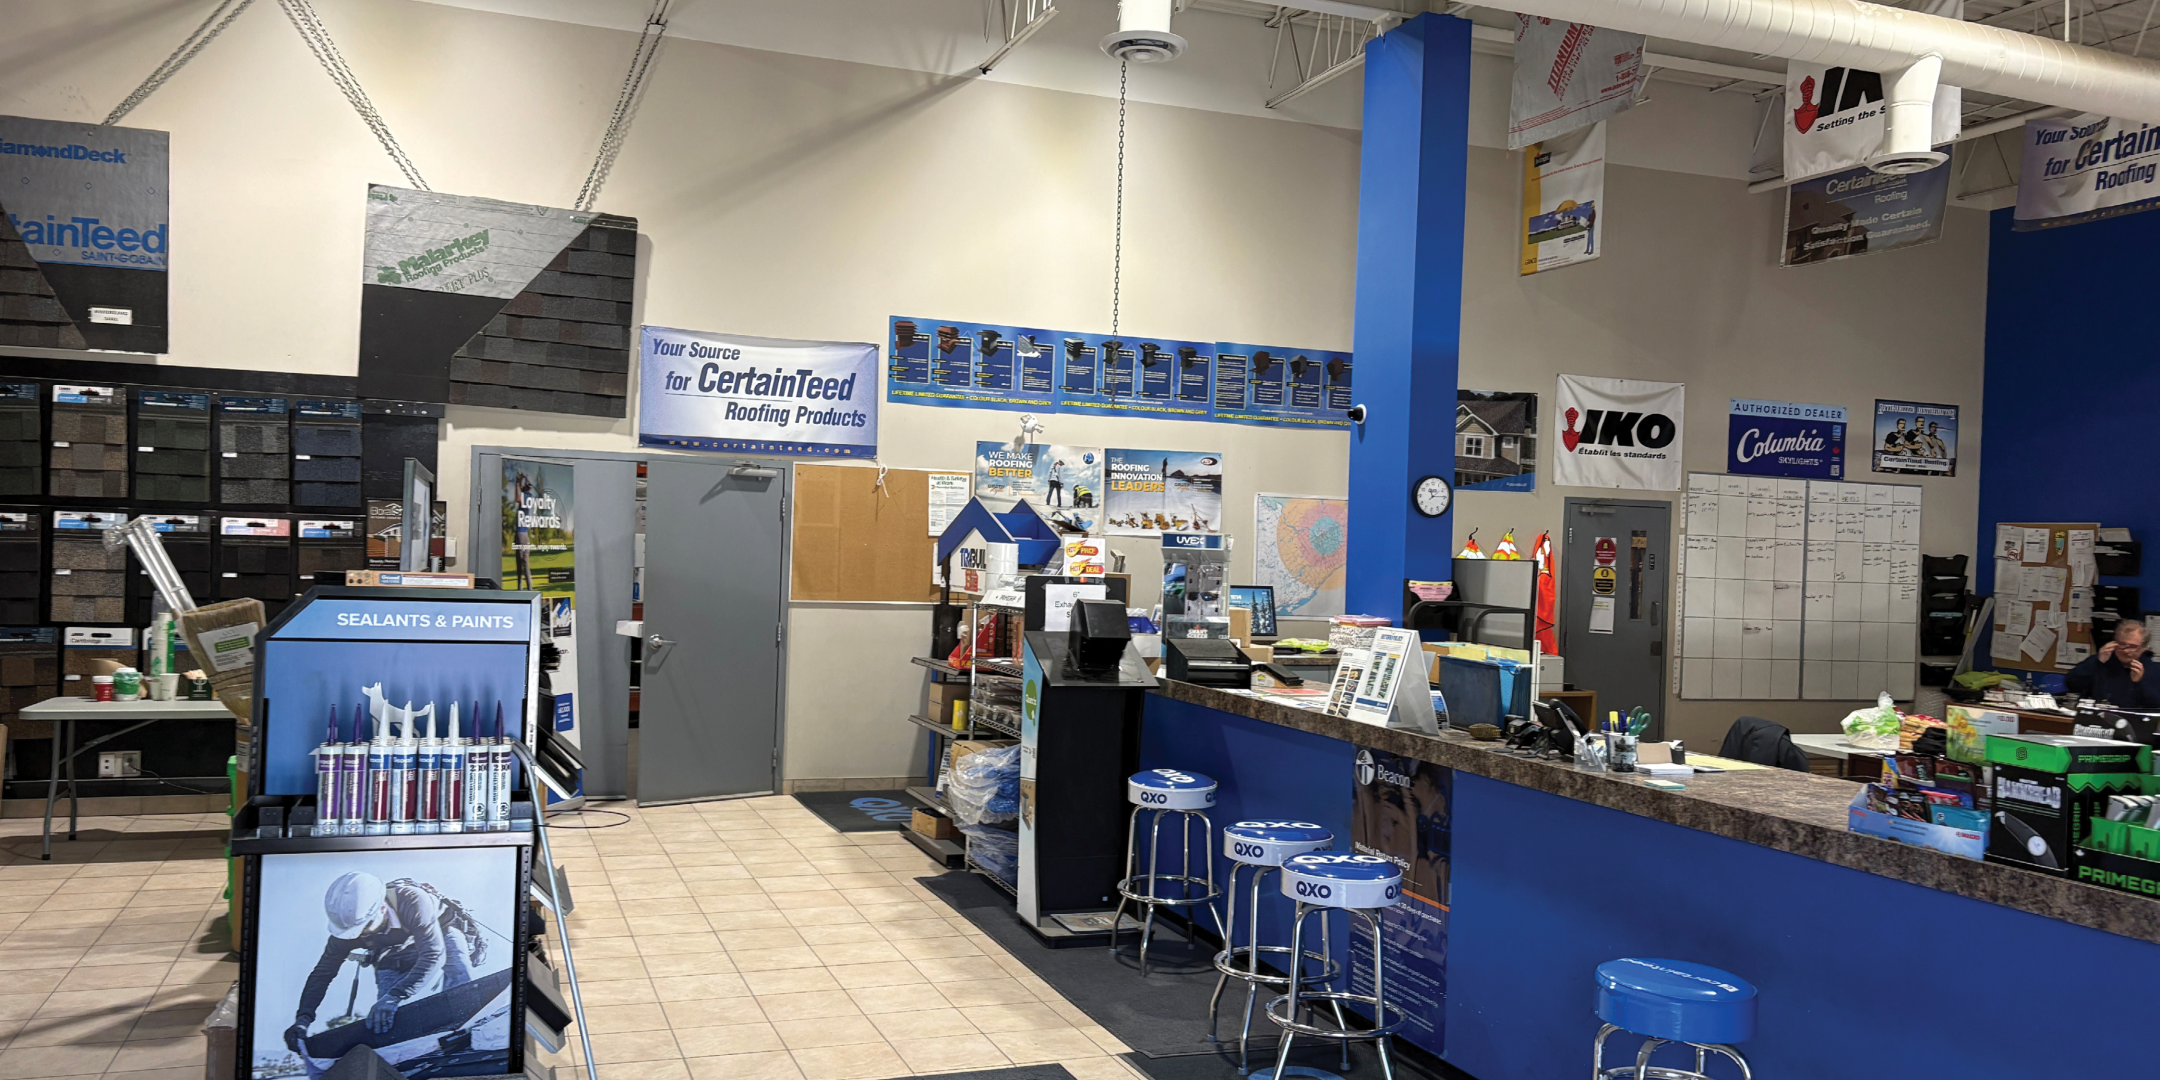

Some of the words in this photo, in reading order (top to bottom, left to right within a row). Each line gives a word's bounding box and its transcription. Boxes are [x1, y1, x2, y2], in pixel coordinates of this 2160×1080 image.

[1547, 22, 1580, 91] TITANIUM
[1816, 116, 1854, 132] Setting
[1858, 109, 1876, 121] the
[2035, 129, 2068, 145] Your
[2044, 157, 2071, 177] for
[2095, 163, 2157, 191] Roofing
[1874, 190, 1907, 204] Roofing
[1811, 222, 1850, 235] Quality
[1850, 217, 1878, 228] Made
[1881, 207, 1922, 221] Certain
[397, 228, 490, 274] Malarkey
[1803, 235, 1864, 250] Satisfaction
[403, 261, 443, 283] Roofing
[443, 246, 485, 268] Products
[467, 267, 490, 284] PLUS
[652, 338, 686, 357] Your
[688, 341, 741, 360] Source
[665, 371, 691, 390] for
[697, 362, 857, 401] CertainTeed
[724, 401, 791, 427] Roofing
[795, 405, 867, 427] Products
[1734, 402, 1801, 417] AUTHORIZED
[1804, 408, 1843, 419] DEALER
[1578, 409, 1676, 449] IKO
[1578, 447, 1608, 456] Établit
[1610, 449, 1621, 457] les
[1624, 451, 1666, 460] standards
[1736, 428, 1826, 463] Columbia
[988, 451, 1005, 459] WE
[1006, 452, 1033, 460] MAKE
[988, 459, 1033, 468] ROOFING
[1777, 456, 1820, 466] SKYLIGHTS
[988, 468, 1033, 478] BETTER
[1111, 463, 1149, 472] ROOFING
[1111, 472, 1163, 481] INNOVATION
[1111, 480, 1165, 492] LEADERS
[520, 492, 557, 515] Loyalty
[517, 510, 561, 529] Rewards
[1176, 535, 1205, 546] UVEX
[337, 613, 431, 628] SEALANTS
[434, 614, 447, 628] &
[452, 615, 514, 629] PAINTS
[1152, 768, 1196, 783] QXO
[1377, 765, 1411, 788] Beacon
[1140, 791, 1168, 804] QXO
[1235, 821, 1322, 829] QXO
[1234, 842, 1264, 858] QXO
[1355, 841, 1374, 856] Material
[1375, 849, 1393, 862] Return
[1394, 856, 1411, 870] Policy
[1293, 855, 1387, 864] QXO
[1296, 881, 1332, 899] QXO
